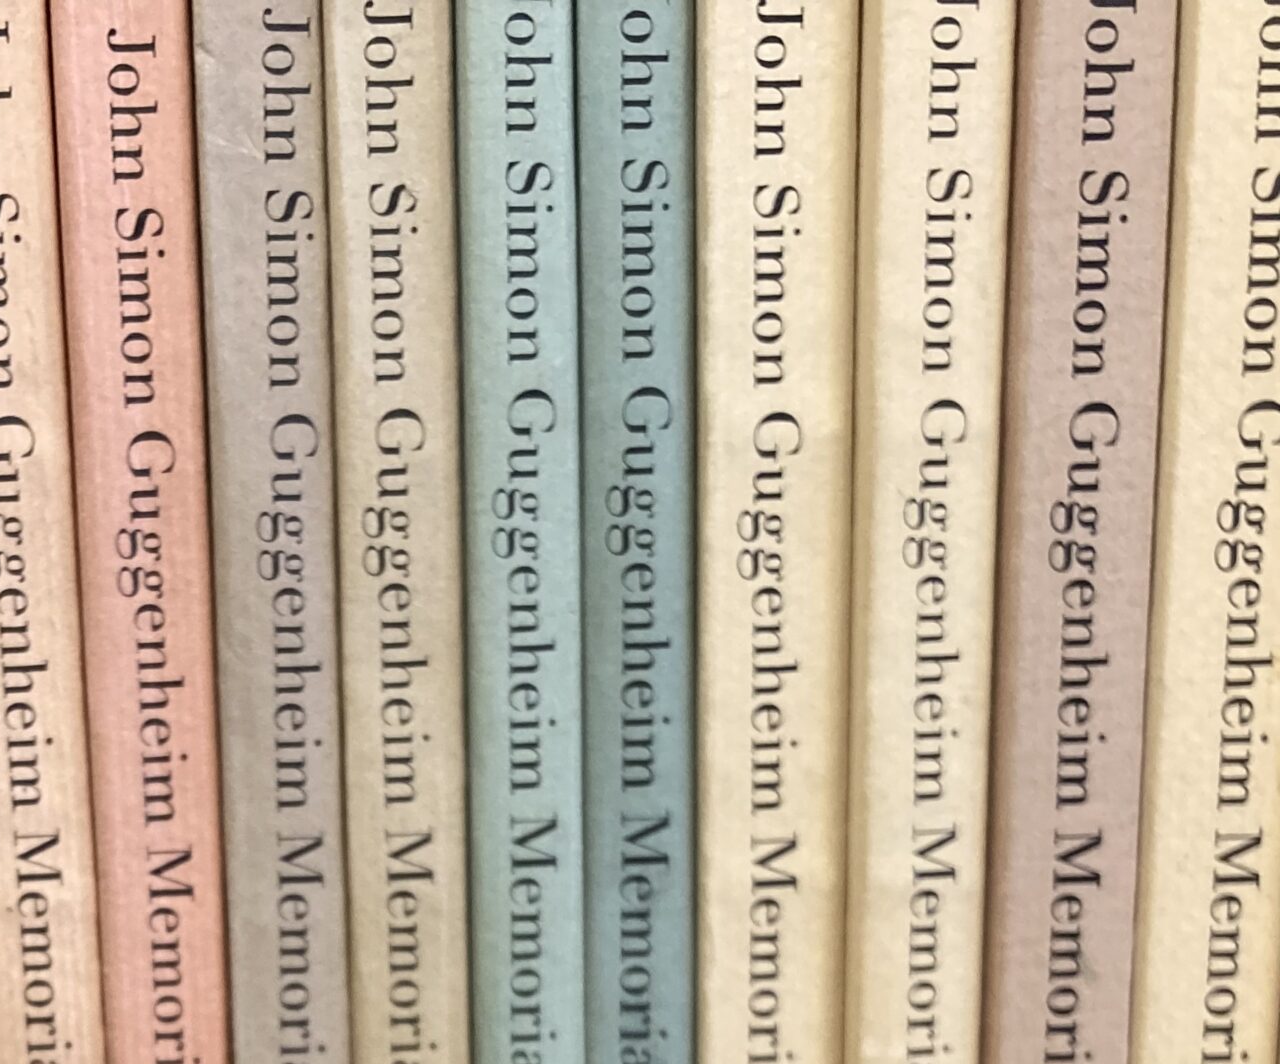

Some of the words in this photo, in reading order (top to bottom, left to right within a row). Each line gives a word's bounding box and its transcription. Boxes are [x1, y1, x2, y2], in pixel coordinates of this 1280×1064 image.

[106, 27, 158, 186] John
[262, 7, 312, 164] John
[363, 0, 414, 157] John
[505, 0, 554, 135] ohn
[620, 0, 670, 133] ohn
[753, 0, 804, 159] John
[114, 207, 166, 407] Simon
[264, 189, 314, 389] Simon
[369, 183, 419, 384] Simon
[505, 160, 554, 363] Simon
[620, 159, 670, 361] Simon
[753, 184, 801, 386] Simon
[923, 168, 972, 372] Simon
[1072, 170, 1130, 376] Simon
[117, 430, 188, 825] Guggenheim
[256, 413, 322, 810] Guggenheim
[362, 407, 430, 806] Guggenheim
[493, 388, 556, 792] Guggenheim
[606, 386, 671, 789] Guggenheim
[737, 411, 801, 812] Guggenheim
[904, 398, 966, 802] Guggenheim
[1048, 401, 1120, 810] Guggenheim
